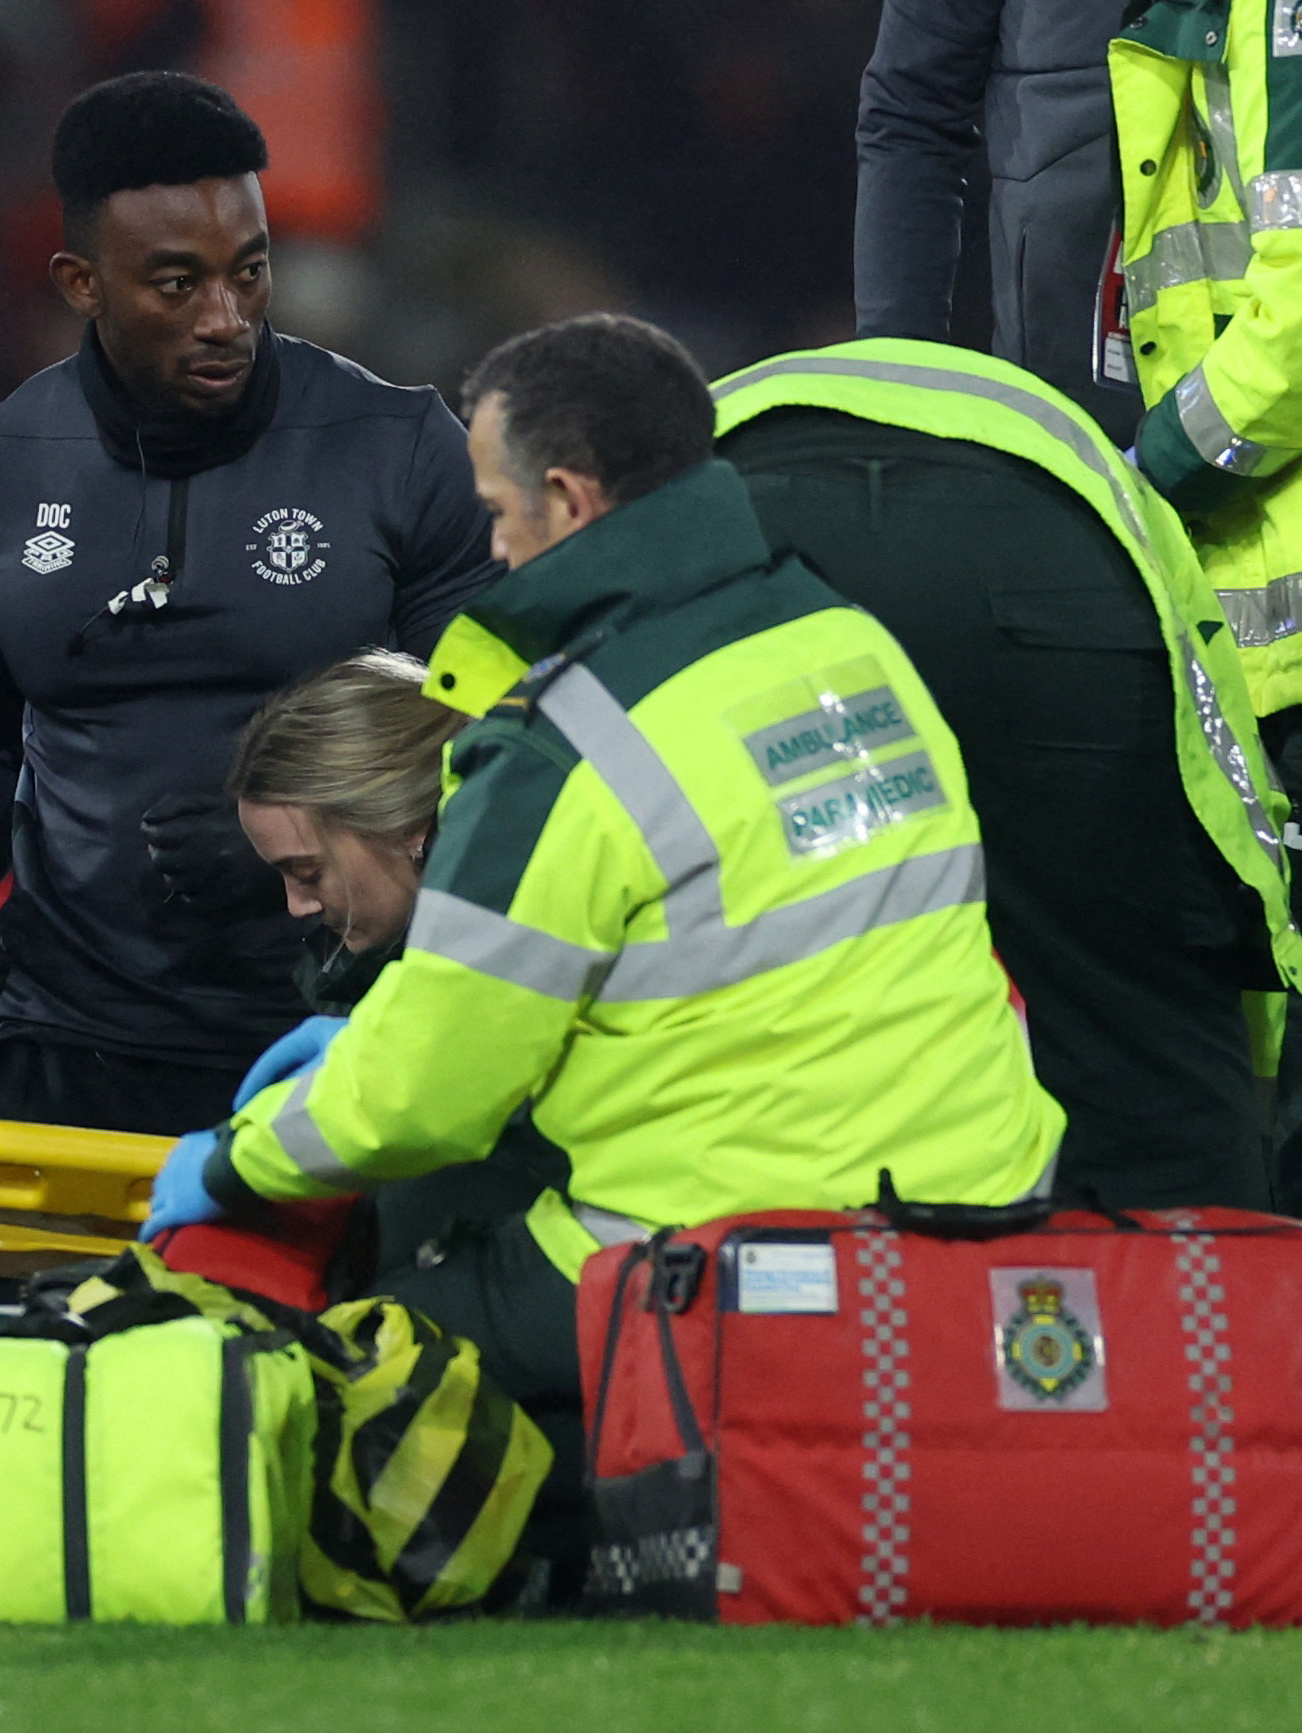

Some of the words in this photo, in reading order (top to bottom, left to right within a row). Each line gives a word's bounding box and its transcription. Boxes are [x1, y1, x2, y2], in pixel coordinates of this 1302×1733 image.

[36, 502, 71, 529] DOC
[252, 508, 288, 534] LUTON
[292, 507, 325, 533] TOWN
[251, 560, 303, 585] FOOTBALL
[302, 558, 326, 581] CLUB
[765, 701, 902, 771] AMBULANCE
